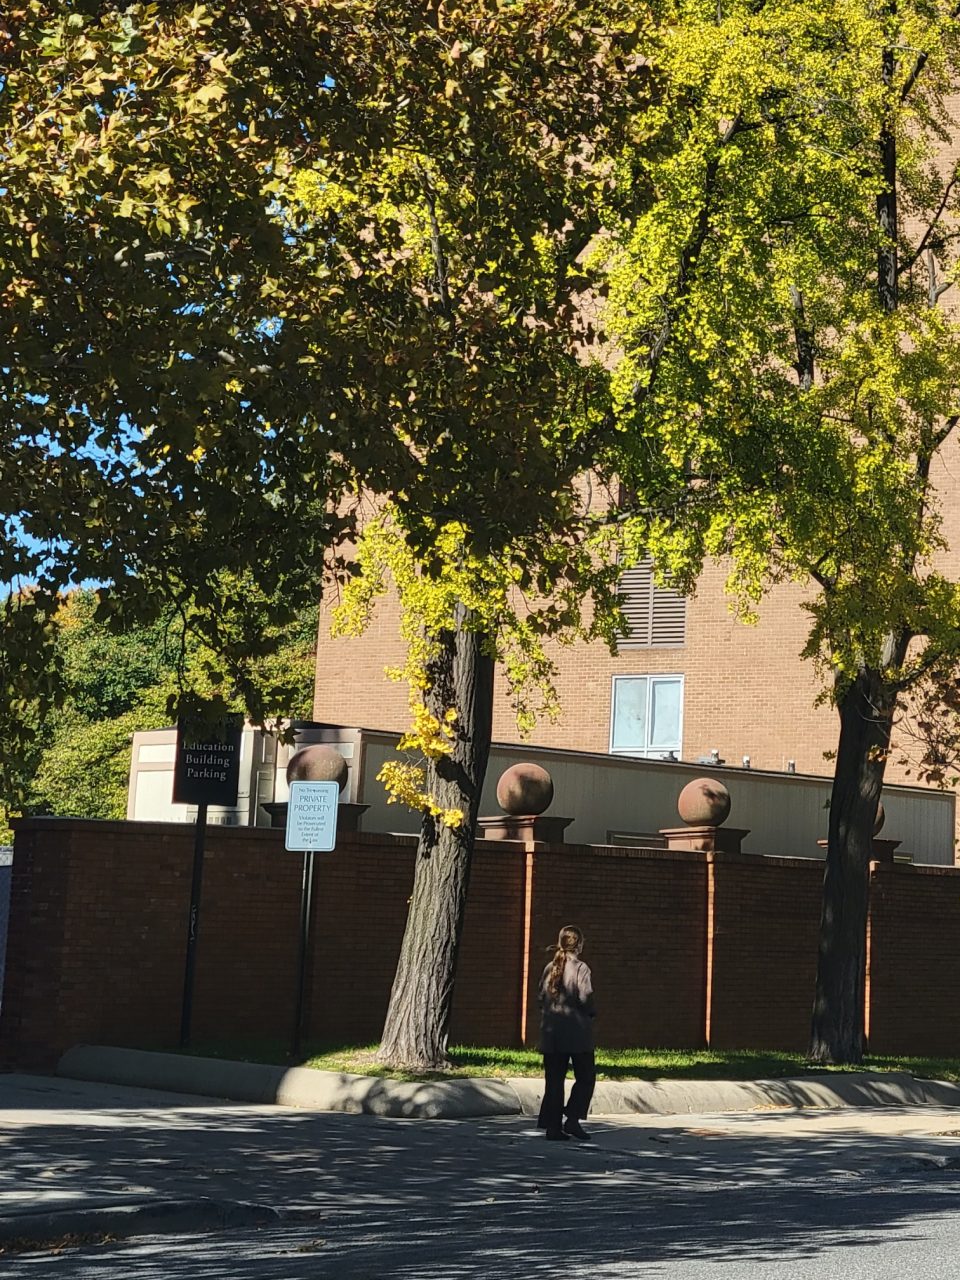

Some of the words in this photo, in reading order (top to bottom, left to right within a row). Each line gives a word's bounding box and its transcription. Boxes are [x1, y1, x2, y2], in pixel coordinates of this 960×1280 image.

[183, 741, 234, 752] Education
[185, 754, 230, 768] Building
[187, 768, 227, 781] Parking
[299, 795, 328, 803] PRIVATE
[294, 804, 331, 812] PROPERTY
